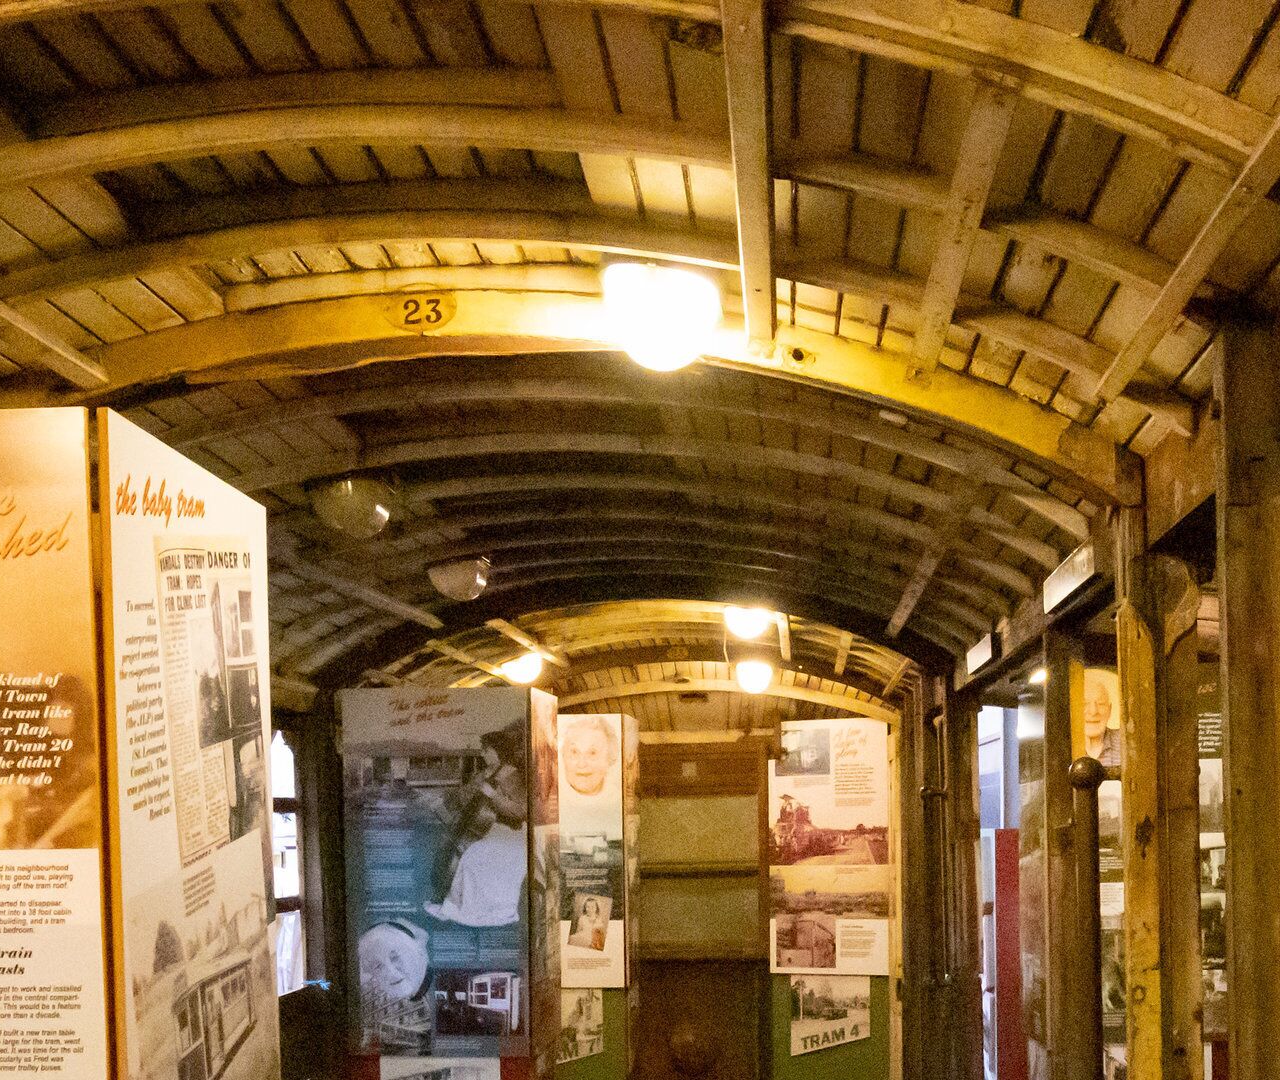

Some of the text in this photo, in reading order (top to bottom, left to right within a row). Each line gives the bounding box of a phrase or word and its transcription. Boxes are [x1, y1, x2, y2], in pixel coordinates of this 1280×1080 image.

[403, 298, 442, 325] 23
[116, 474, 205, 528] the baby tram
[160, 554, 205, 572] VANDALS DESTROY
[208, 551, 238, 569] DANGER
[177, 595, 193, 611] CLINIC
[45, 673, 63, 688] of
[6, 690, 48, 702] Town
[2, 707, 40, 719] tram
[42, 705, 72, 718] like
[16, 722, 52, 738] Ray,
[2, 739, 47, 752] Tram
[49, 738, 74, 751] 20
[16, 755, 62, 768] didn't
[17, 773, 31, 784] to
[34, 772, 53, 784] do
[801, 1023, 860, 1050] TRAM 4
[16, 1063, 39, 1072] trolley
